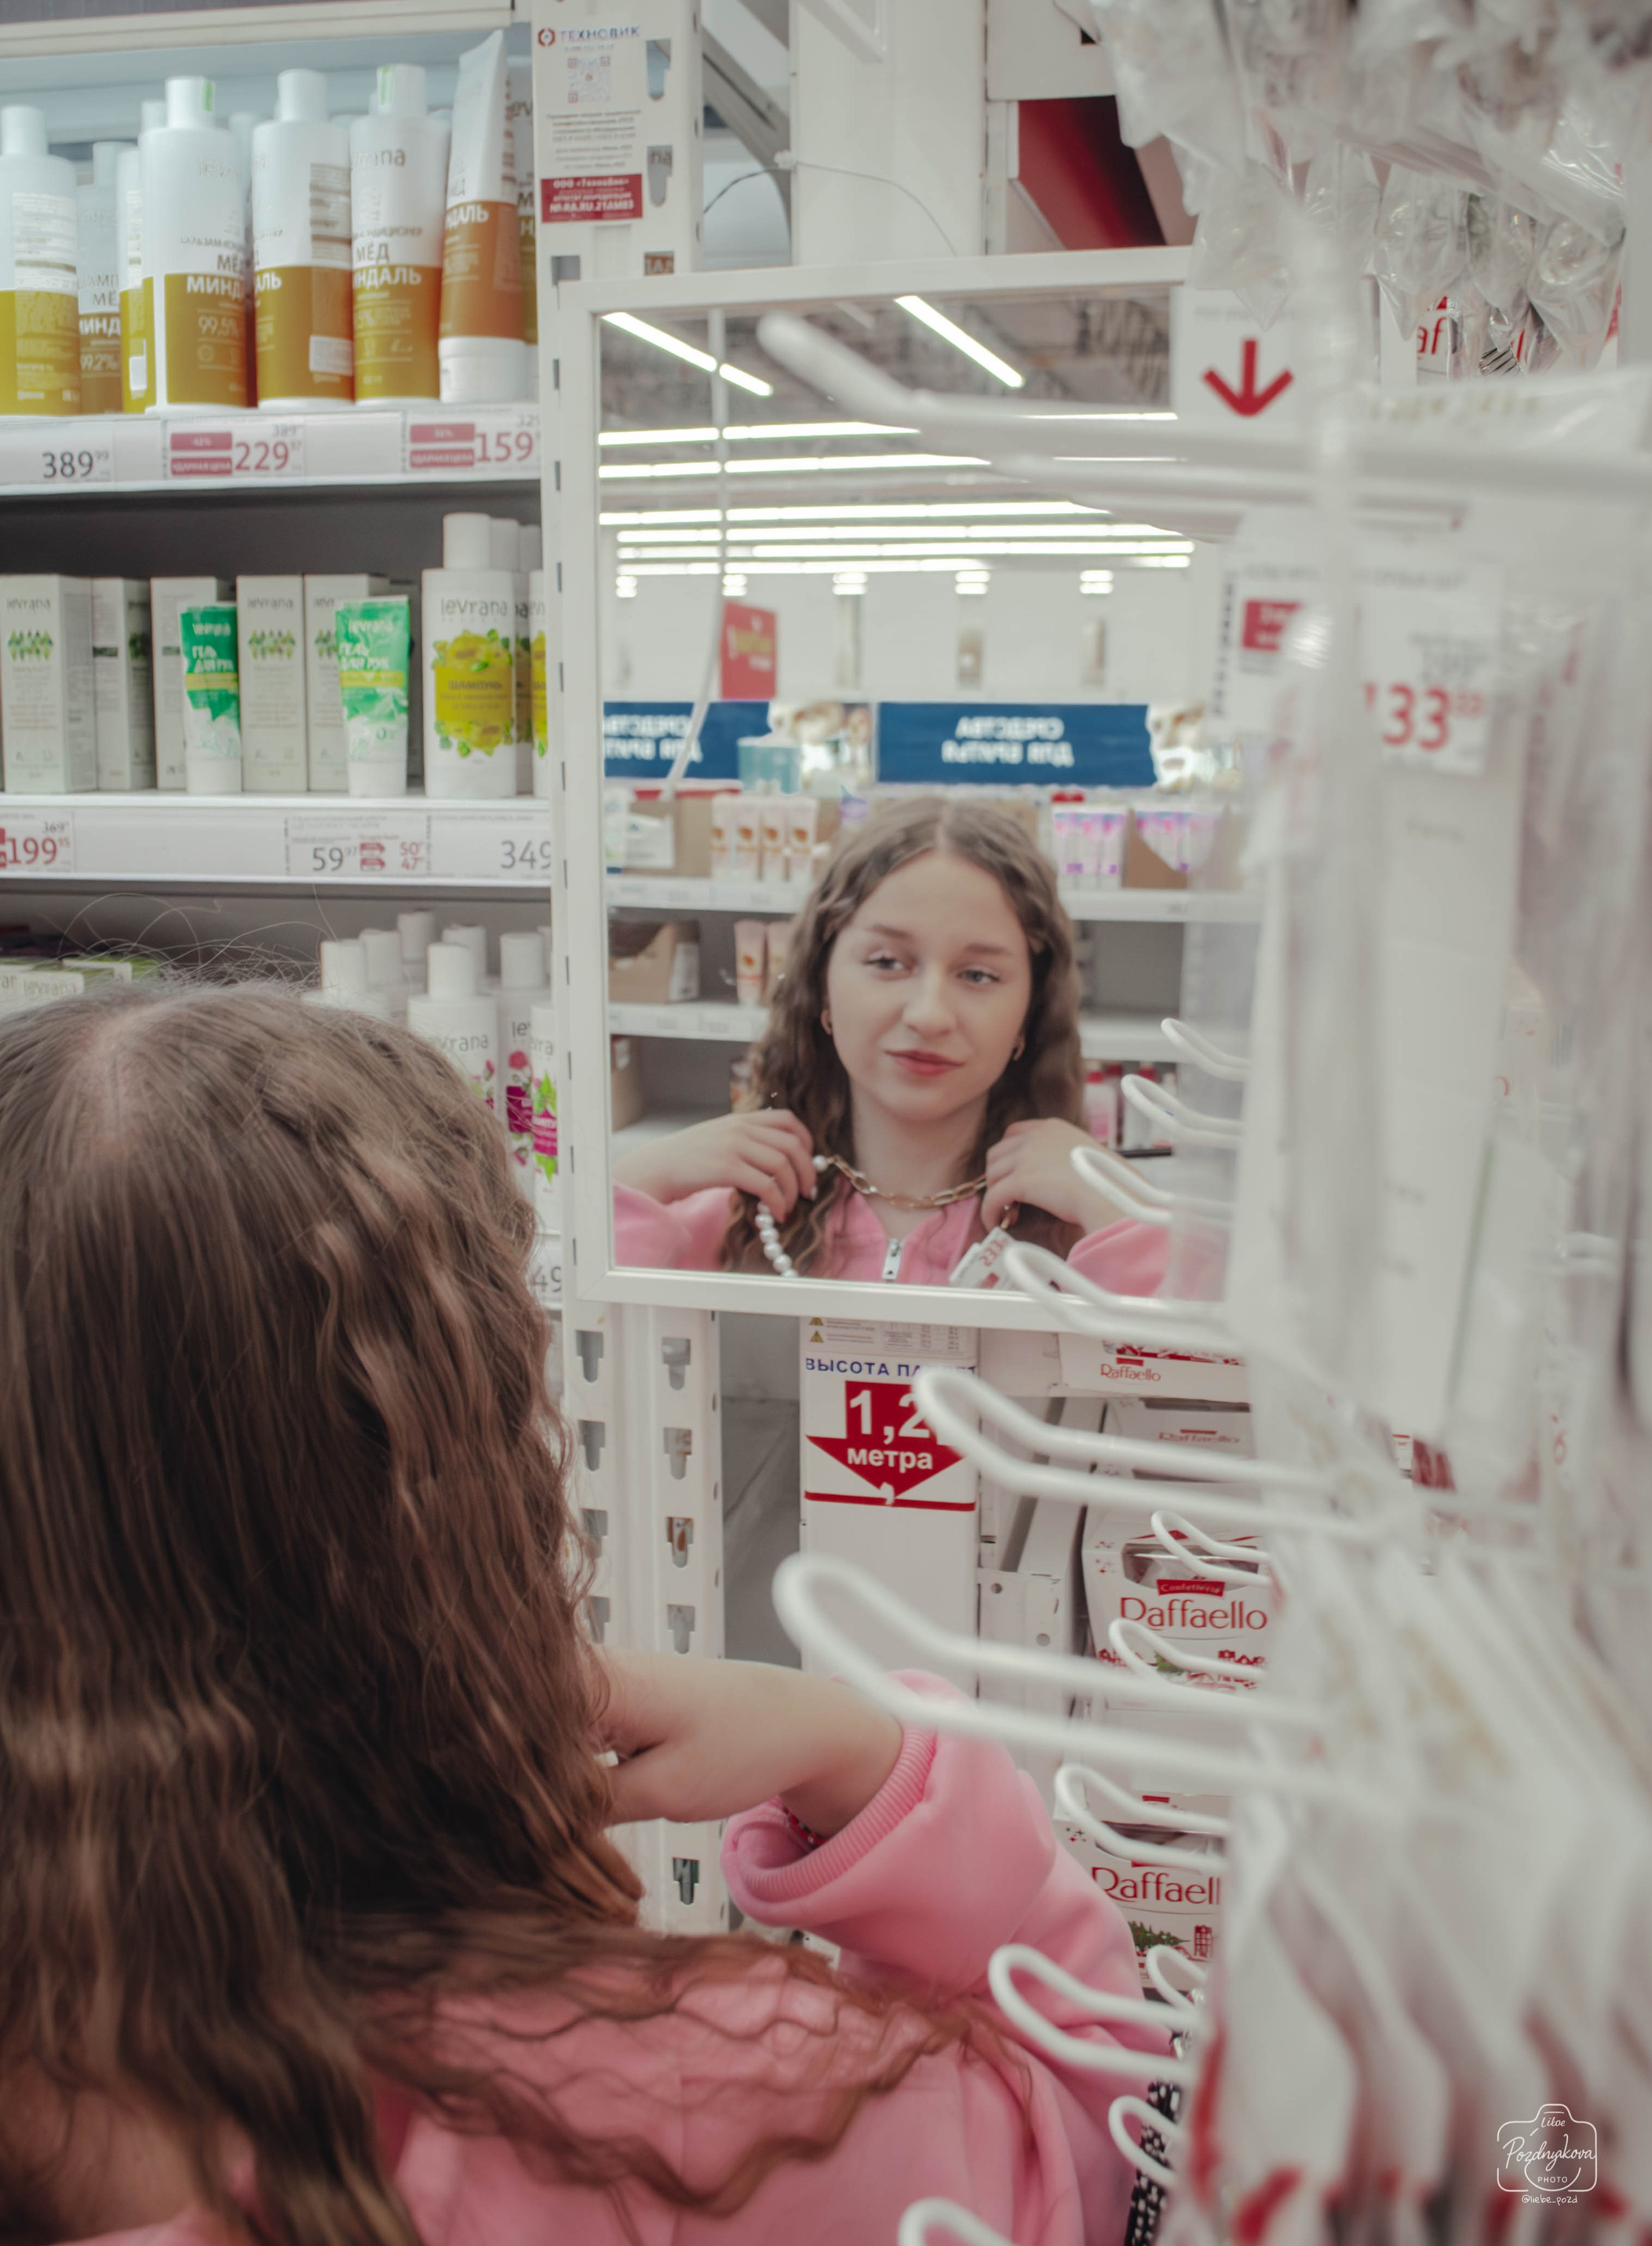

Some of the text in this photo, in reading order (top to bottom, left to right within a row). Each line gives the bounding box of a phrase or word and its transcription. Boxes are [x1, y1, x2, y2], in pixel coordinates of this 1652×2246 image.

[235, 442, 289, 471] 229
[476, 432, 534, 463] 159
[41, 452, 94, 479] 389
[440, 597, 509, 618] levrana
[6, 837, 57, 865] 199
[312, 847, 345, 872] 59
[498, 840, 551, 870] 349
[806, 1358, 889, 1376] ВЫСОТА
[1100, 1364, 1162, 1382] Raffaello
[849, 1390, 930, 1445] 1,2
[847, 1448, 933, 1473] метра
[1120, 1596, 1268, 1631] Raffaello
